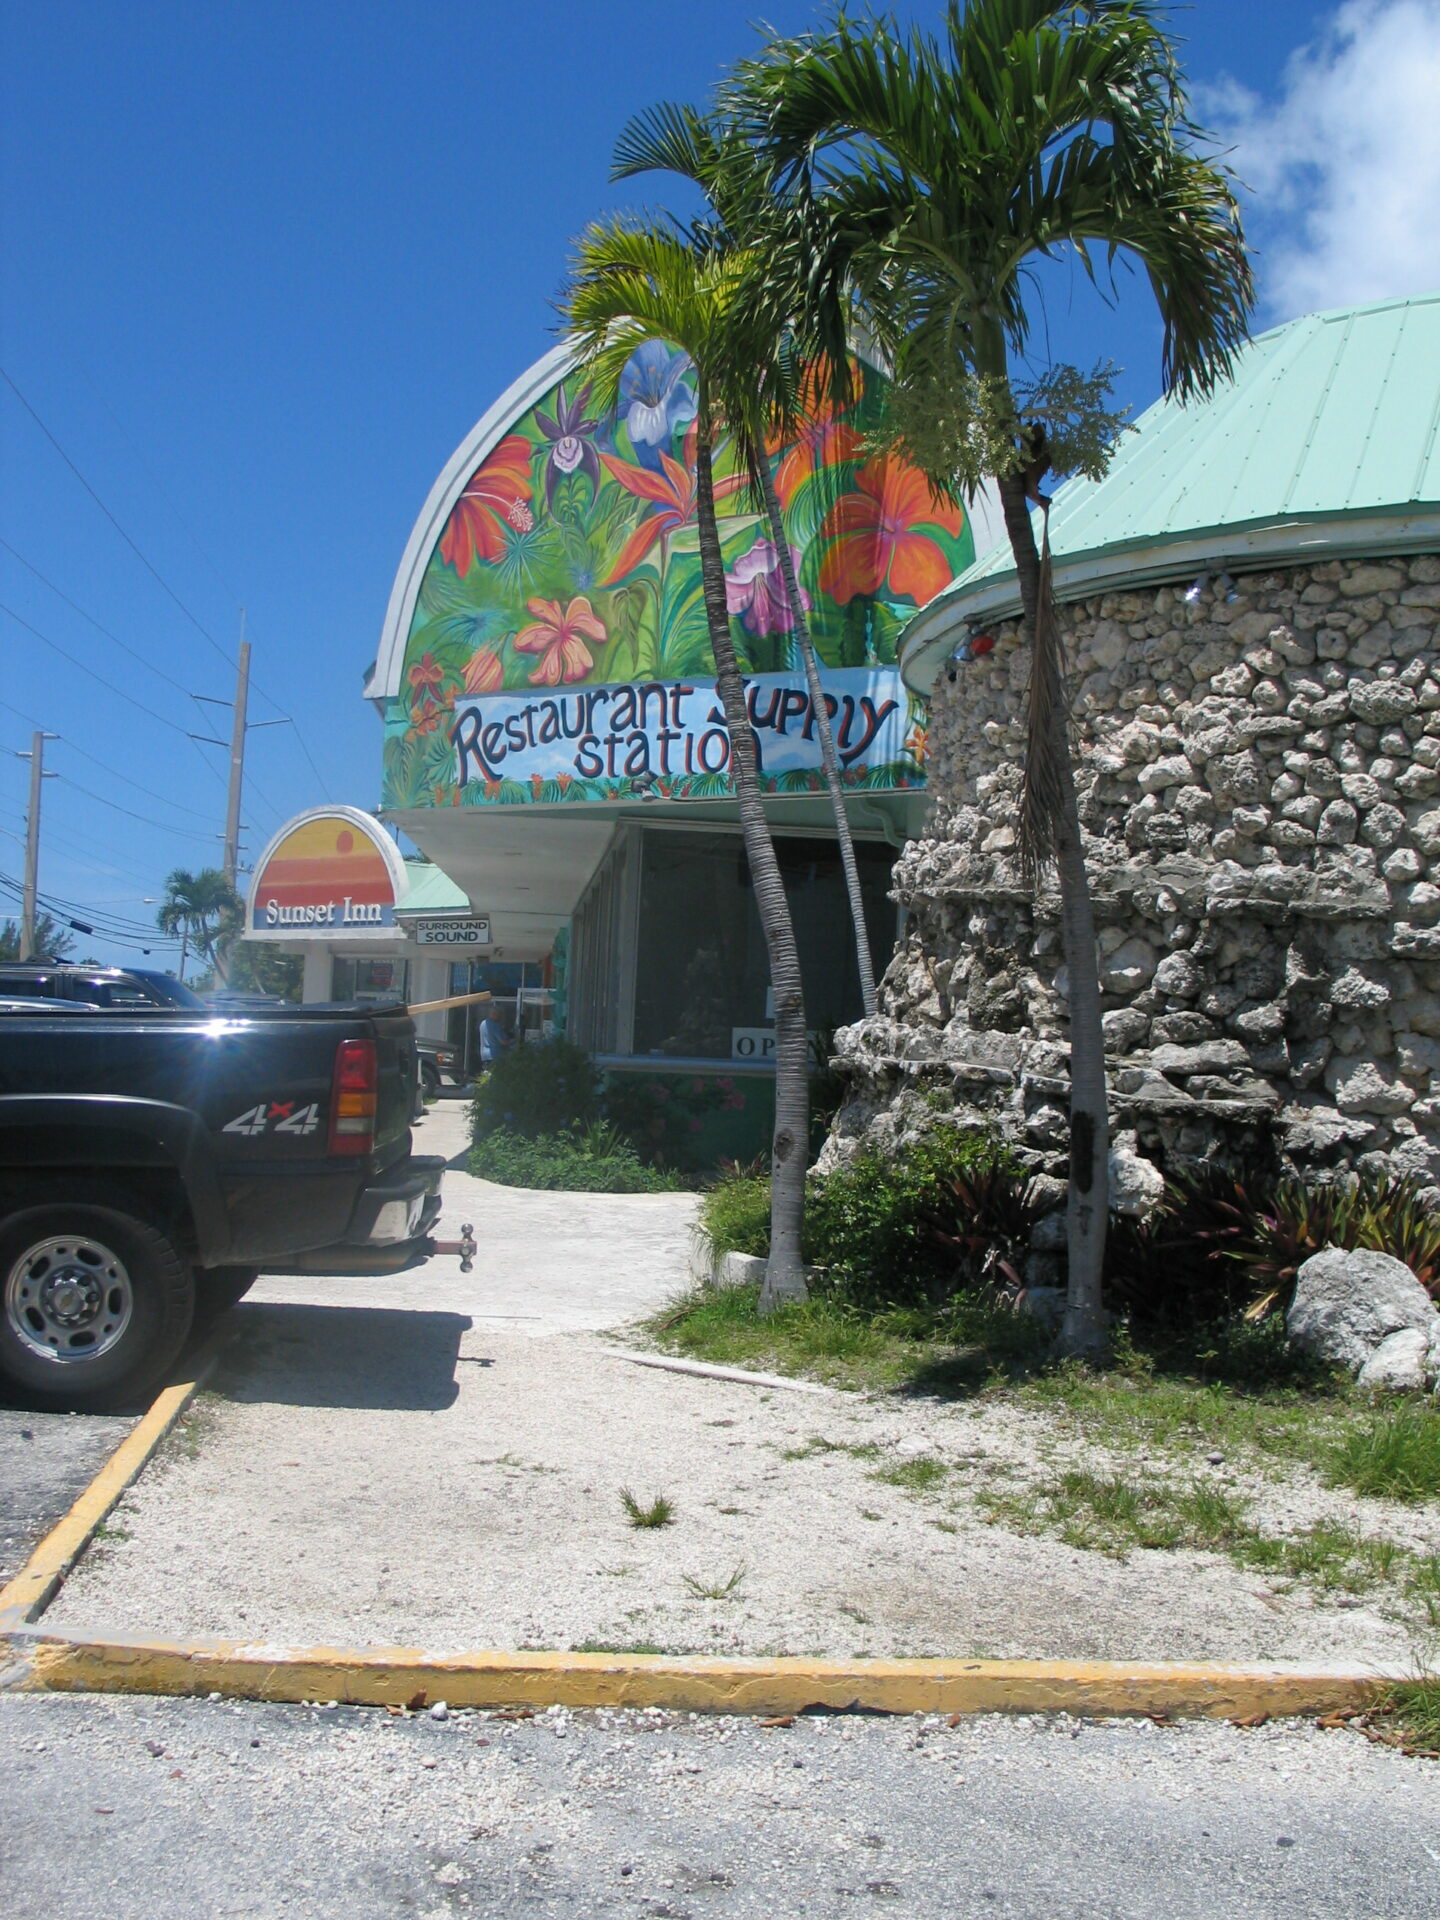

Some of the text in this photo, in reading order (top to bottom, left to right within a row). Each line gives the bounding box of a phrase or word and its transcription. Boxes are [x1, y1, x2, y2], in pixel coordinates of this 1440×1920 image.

[447, 683, 694, 788] Restaurant
[266, 896, 383, 924] Sunset Inn
[418, 921, 487, 931] SURROUND
[425, 931, 479, 942] SOUND
